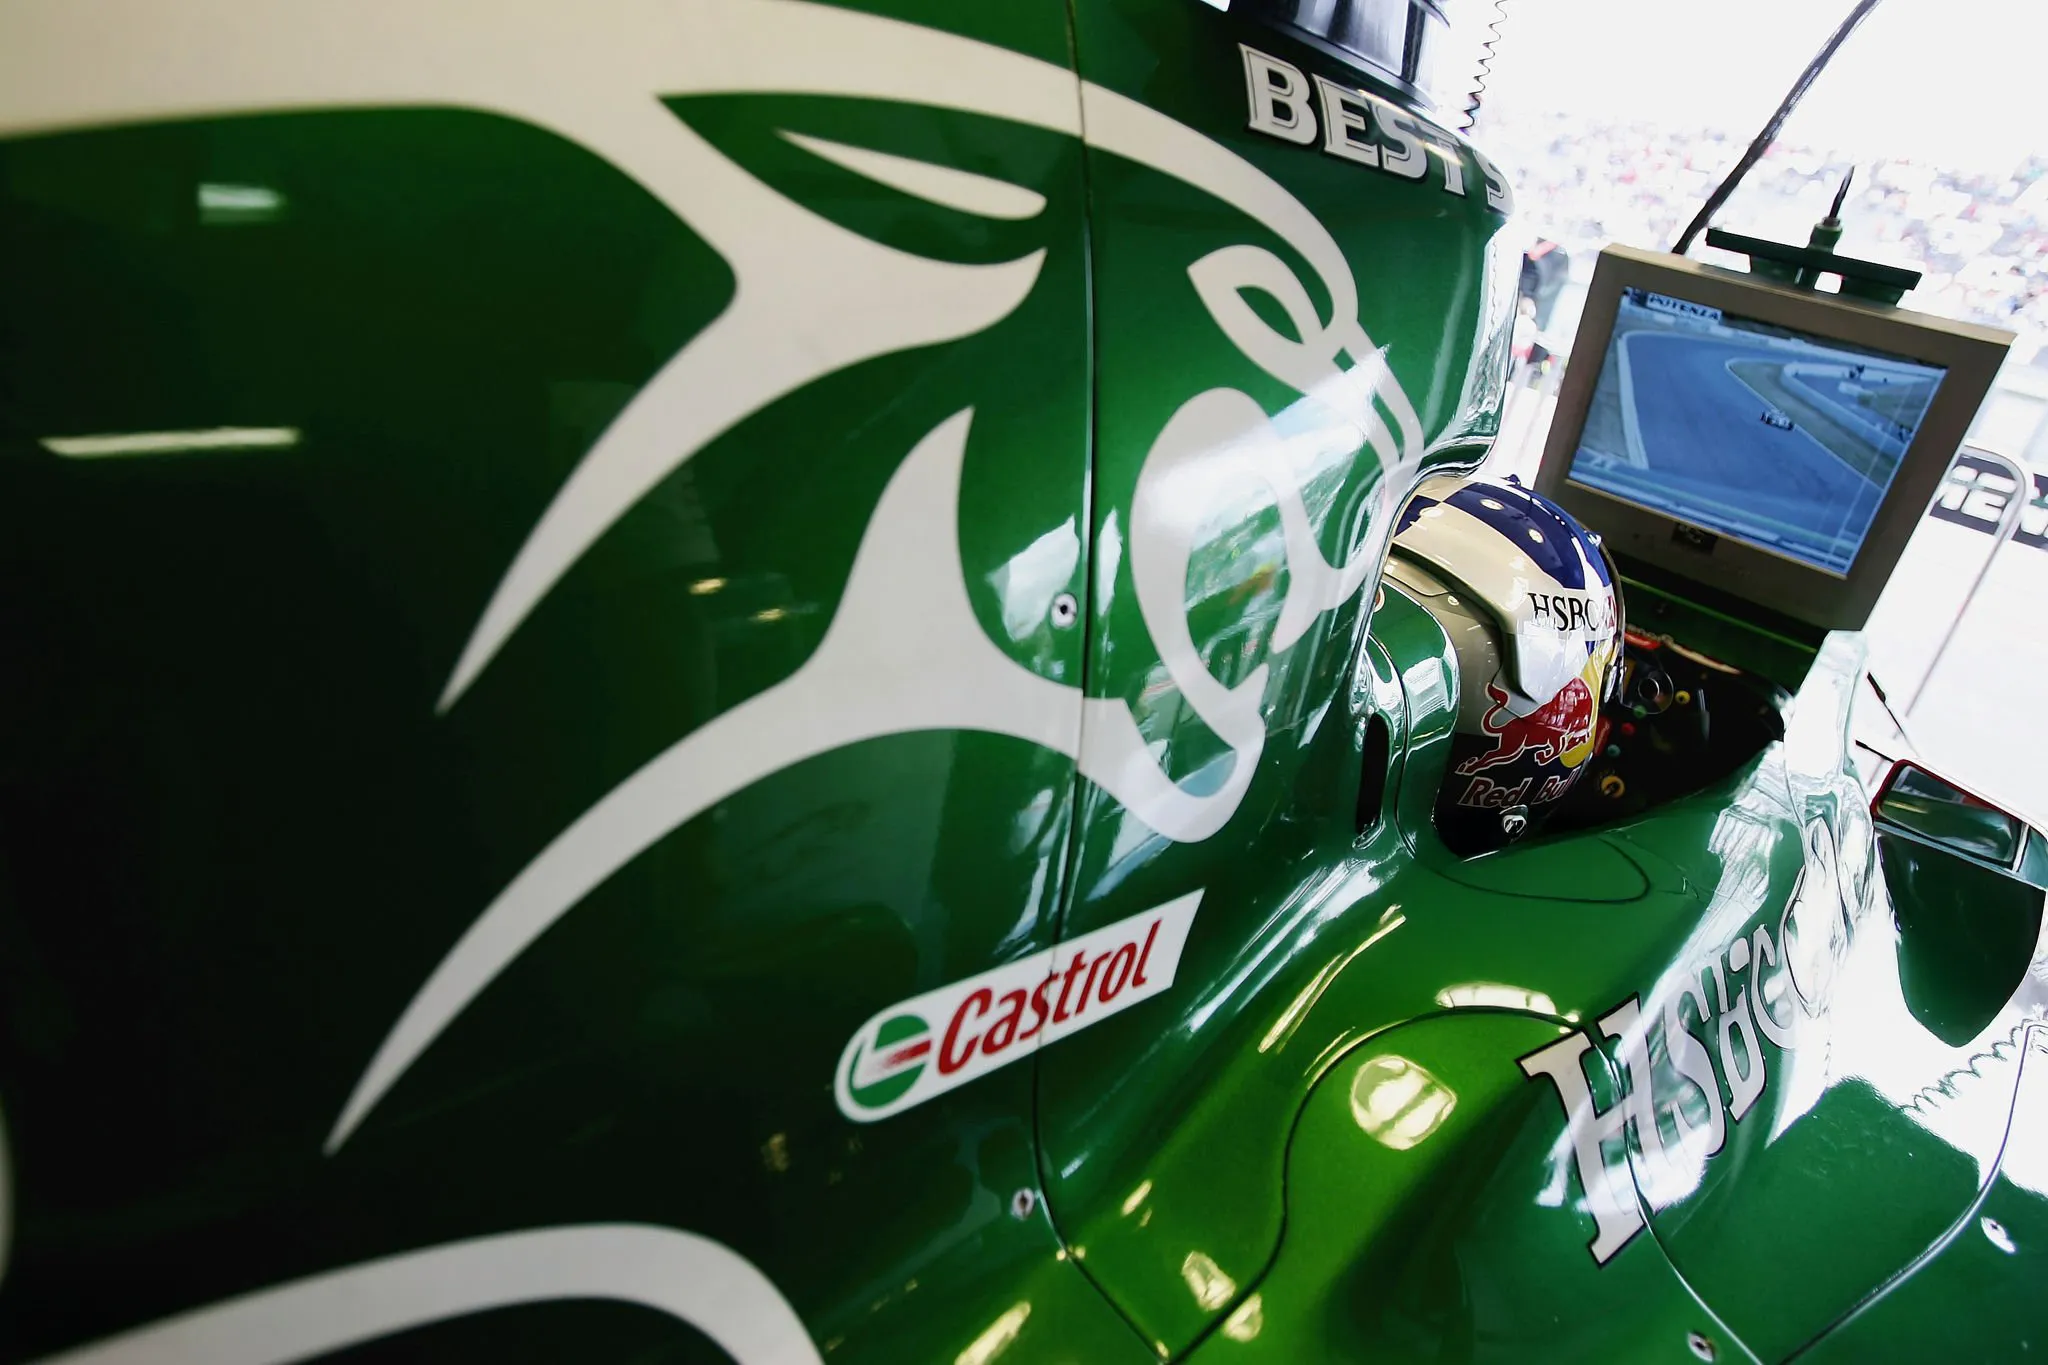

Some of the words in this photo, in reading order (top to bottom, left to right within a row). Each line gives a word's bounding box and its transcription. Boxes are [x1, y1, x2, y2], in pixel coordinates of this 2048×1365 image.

[1238, 43, 1465, 195] BEST
[1528, 592, 1599, 631] HSBC
[1457, 776, 1533, 808] Red
[938, 917, 1163, 1078] Castrol
